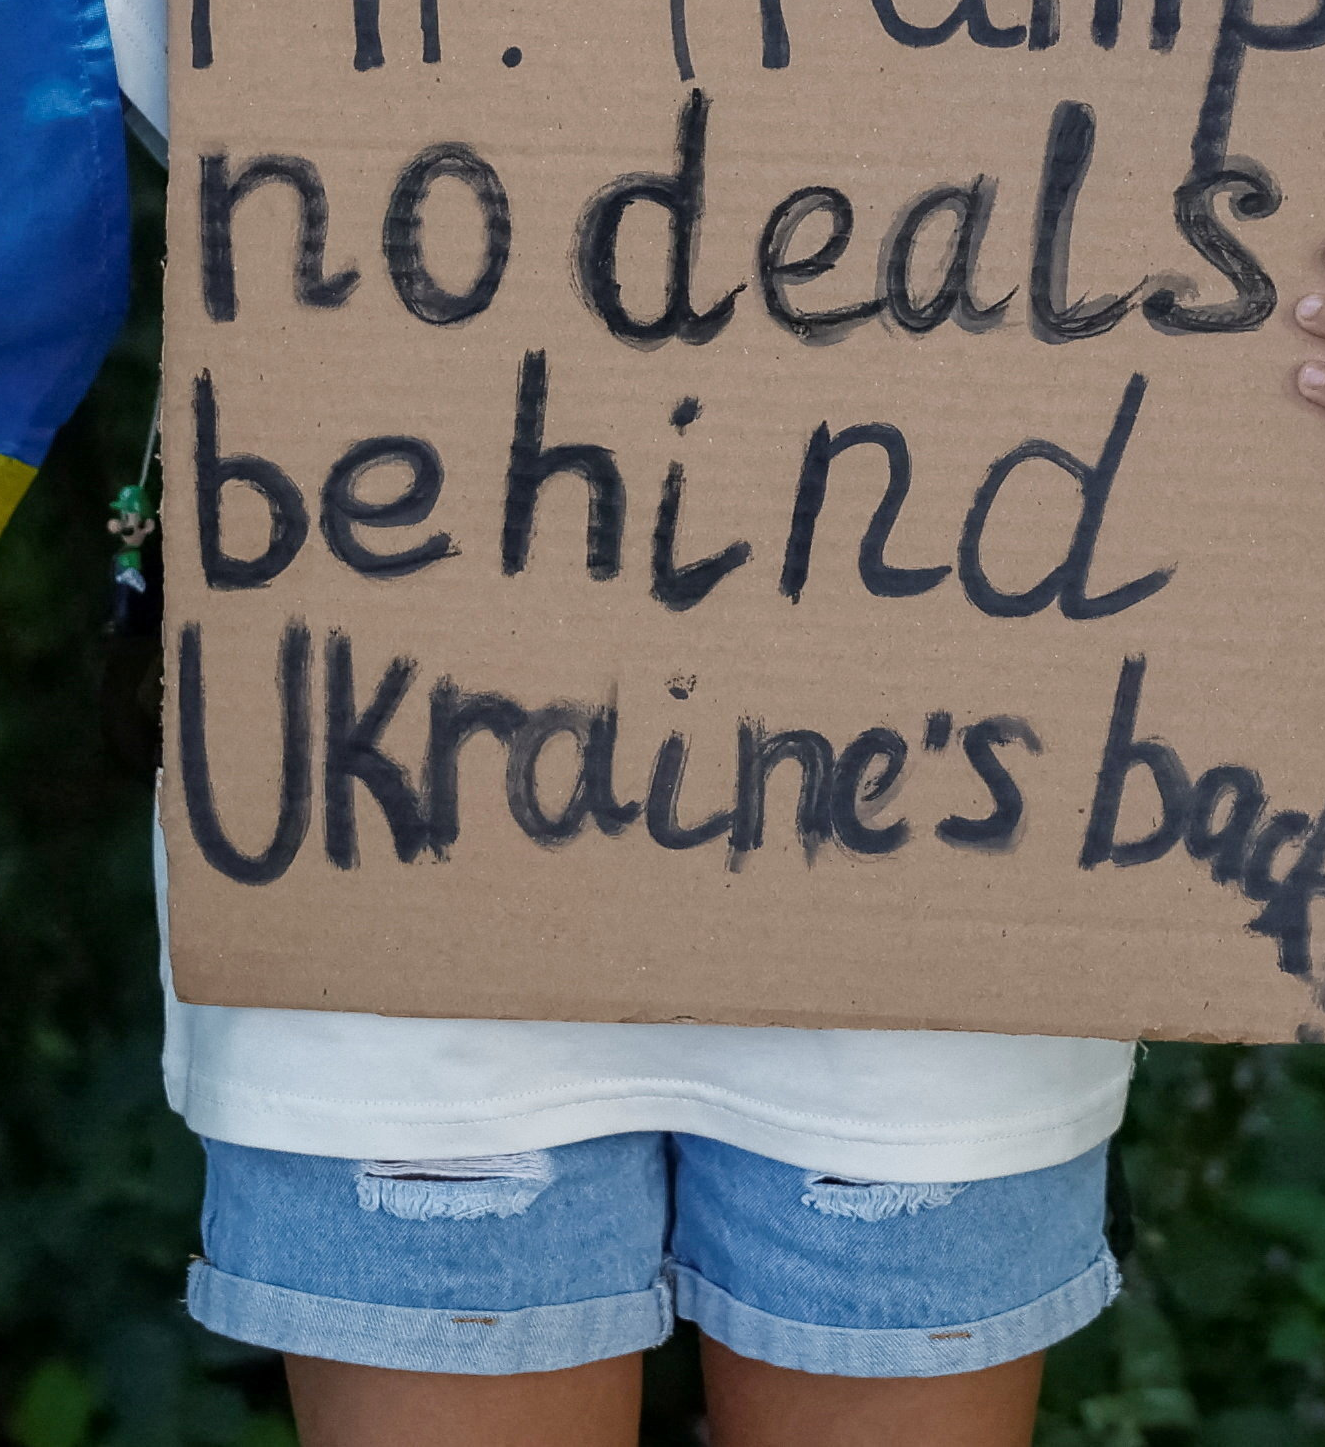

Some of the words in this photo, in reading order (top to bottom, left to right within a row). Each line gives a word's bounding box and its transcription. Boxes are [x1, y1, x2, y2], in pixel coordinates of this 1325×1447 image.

[199, 145, 513, 327] no
[570, 86, 1282, 347] deals
[192, 349, 1176, 620] behind
